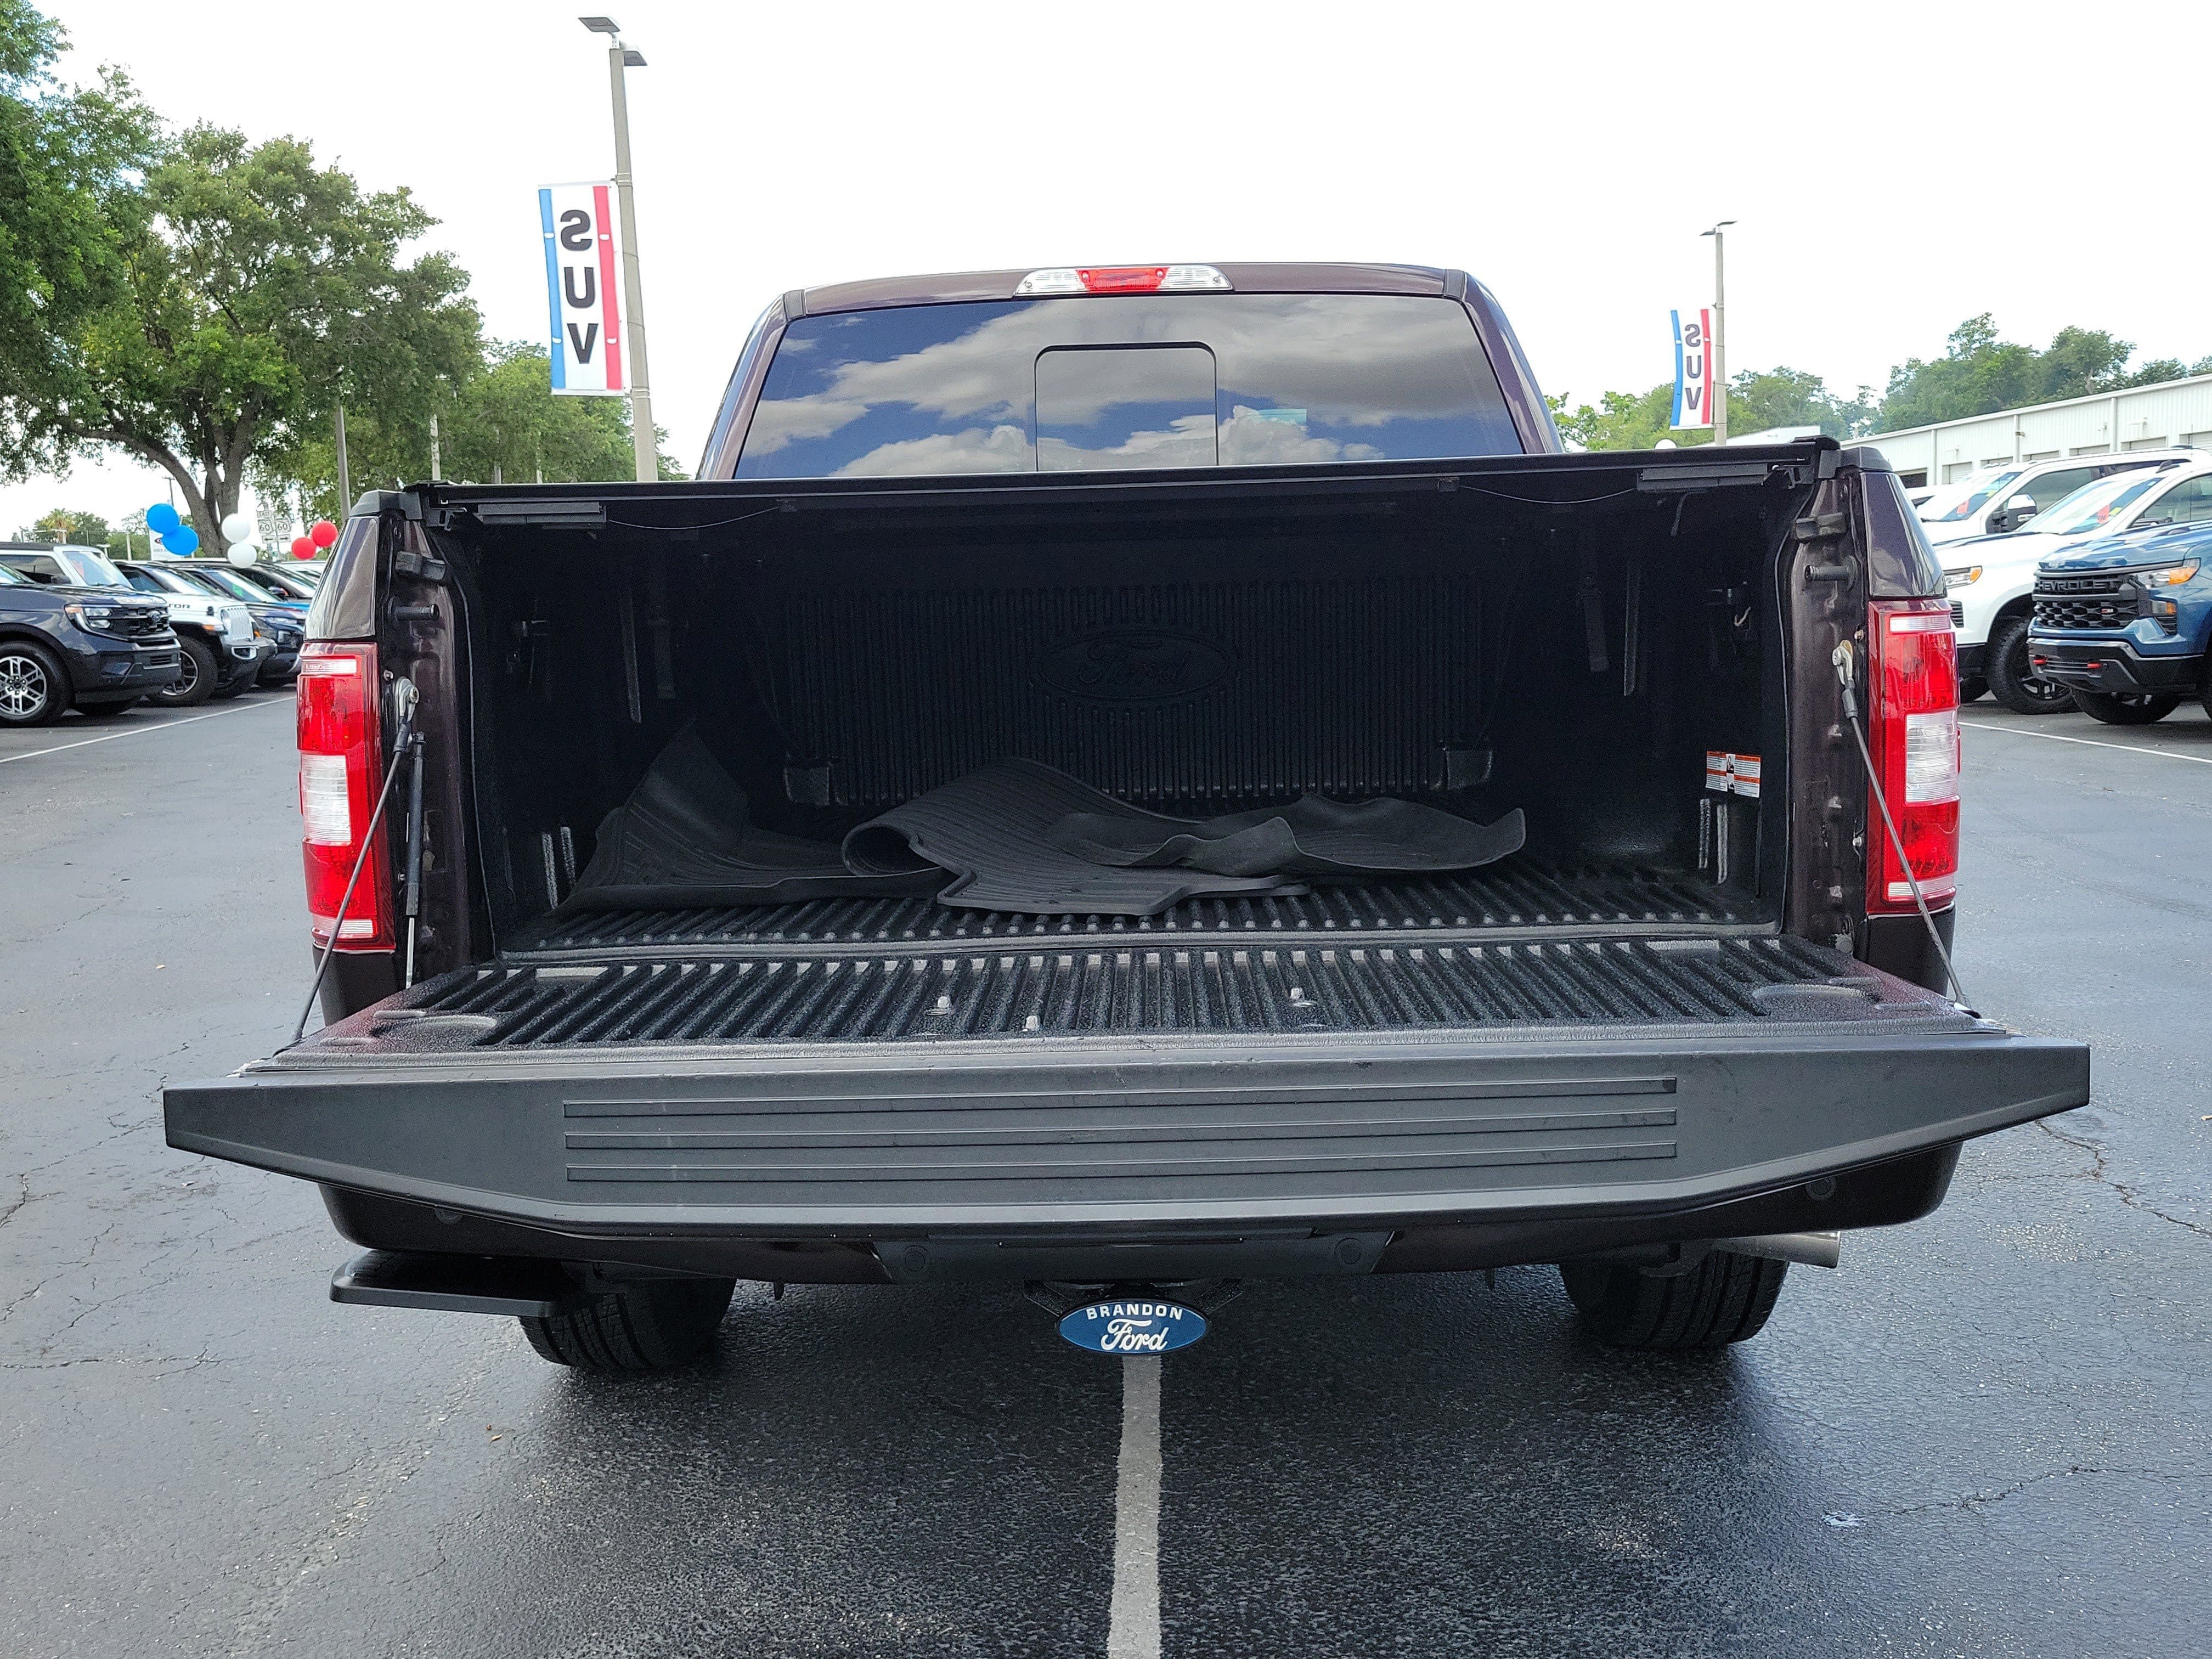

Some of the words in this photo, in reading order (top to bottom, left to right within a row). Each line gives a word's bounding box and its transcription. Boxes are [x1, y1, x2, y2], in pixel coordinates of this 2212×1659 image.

[2034, 579, 2122, 591] CHEVROLET
[1086, 1303, 1183, 1321] BRANDON
[1100, 1318, 1169, 1351] Ford
